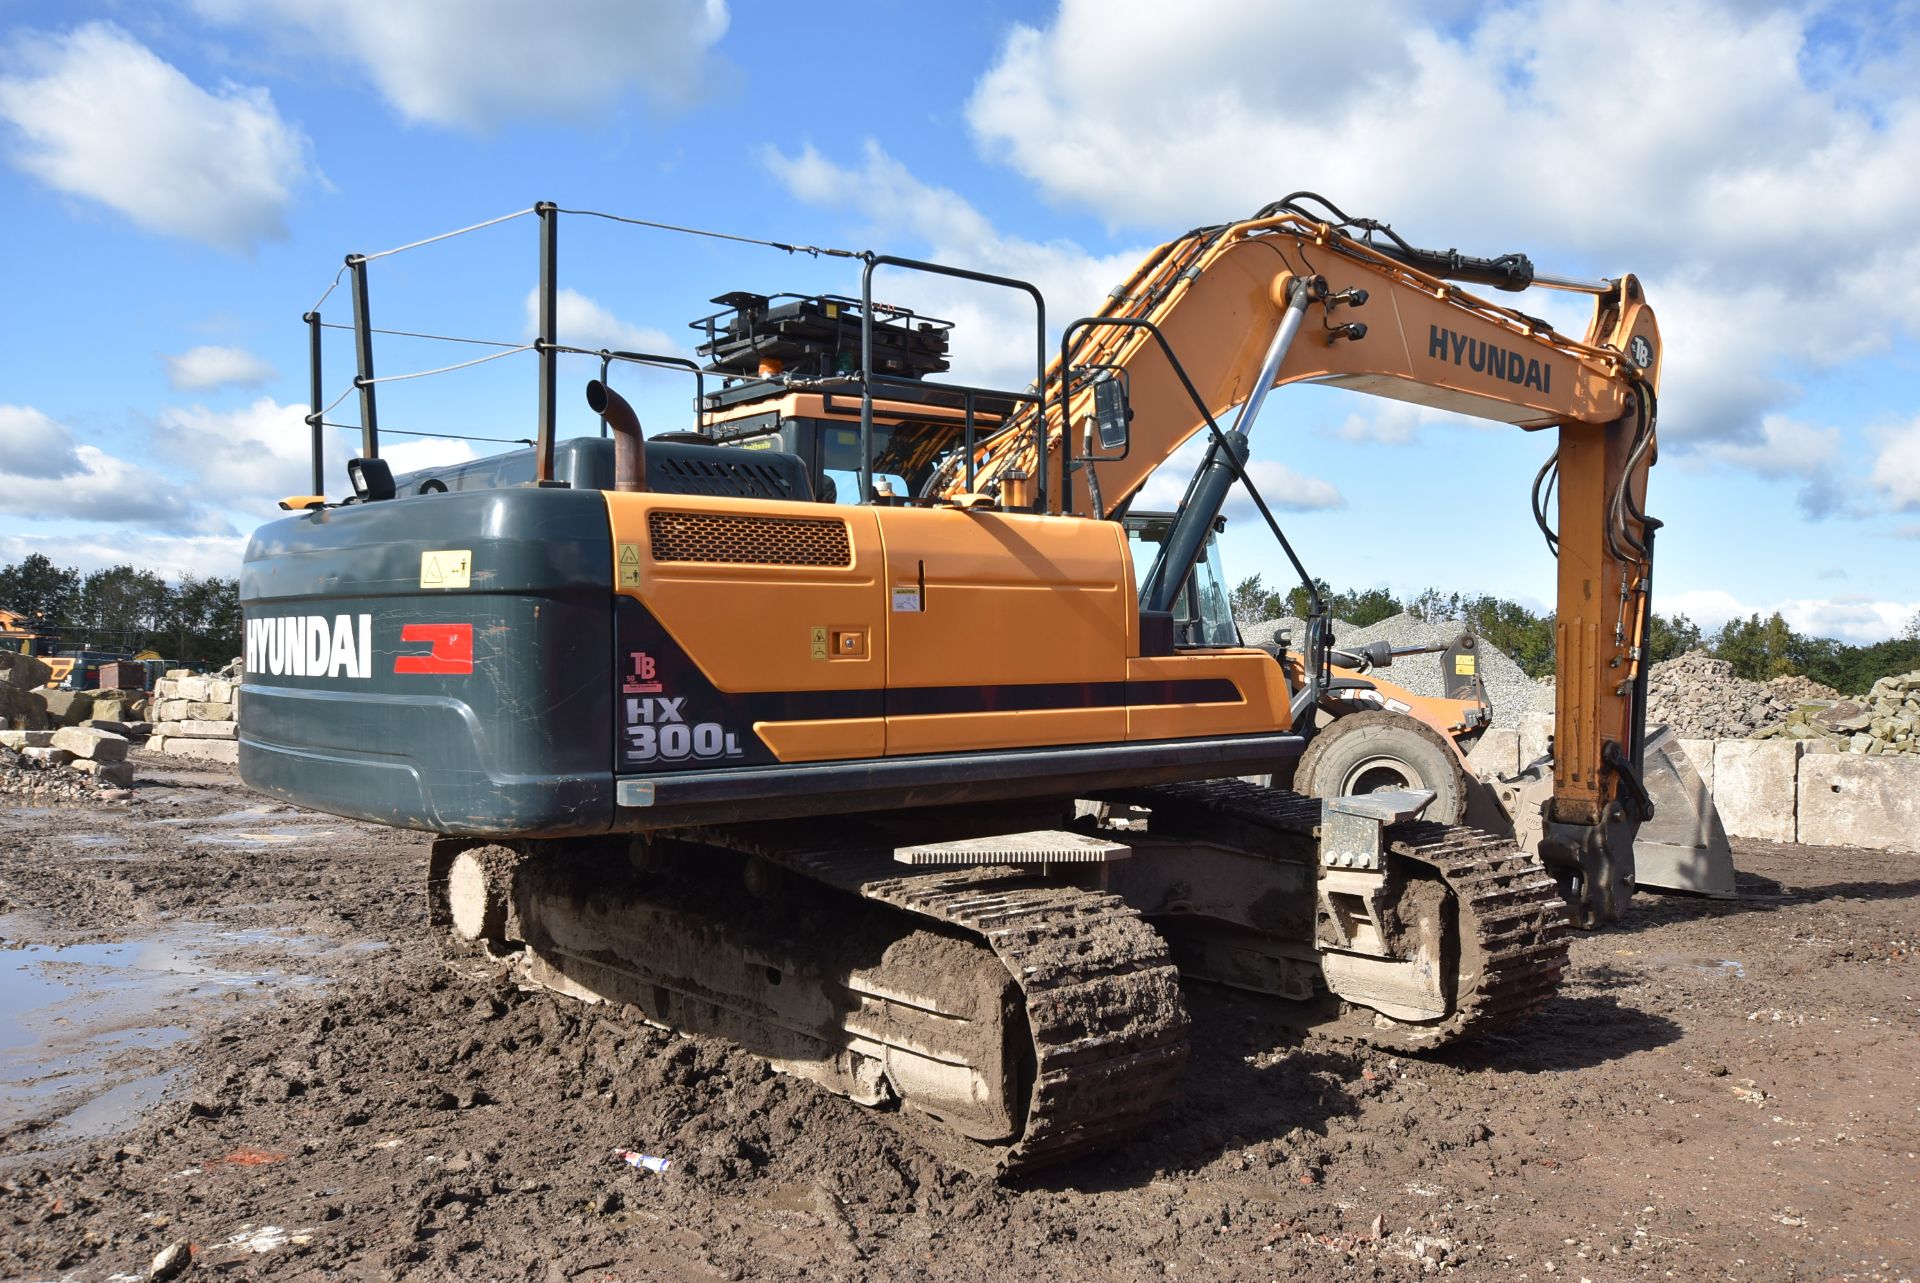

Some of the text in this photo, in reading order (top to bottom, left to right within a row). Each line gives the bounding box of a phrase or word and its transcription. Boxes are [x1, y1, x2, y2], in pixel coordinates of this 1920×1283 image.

[1429, 325, 1551, 394] HYUNDAI
[1634, 336, 1648, 368] TB
[246, 613, 372, 679] HYUNDAI
[630, 652, 656, 680] TB
[626, 697, 685, 724] HX
[626, 722, 743, 760] 300L
